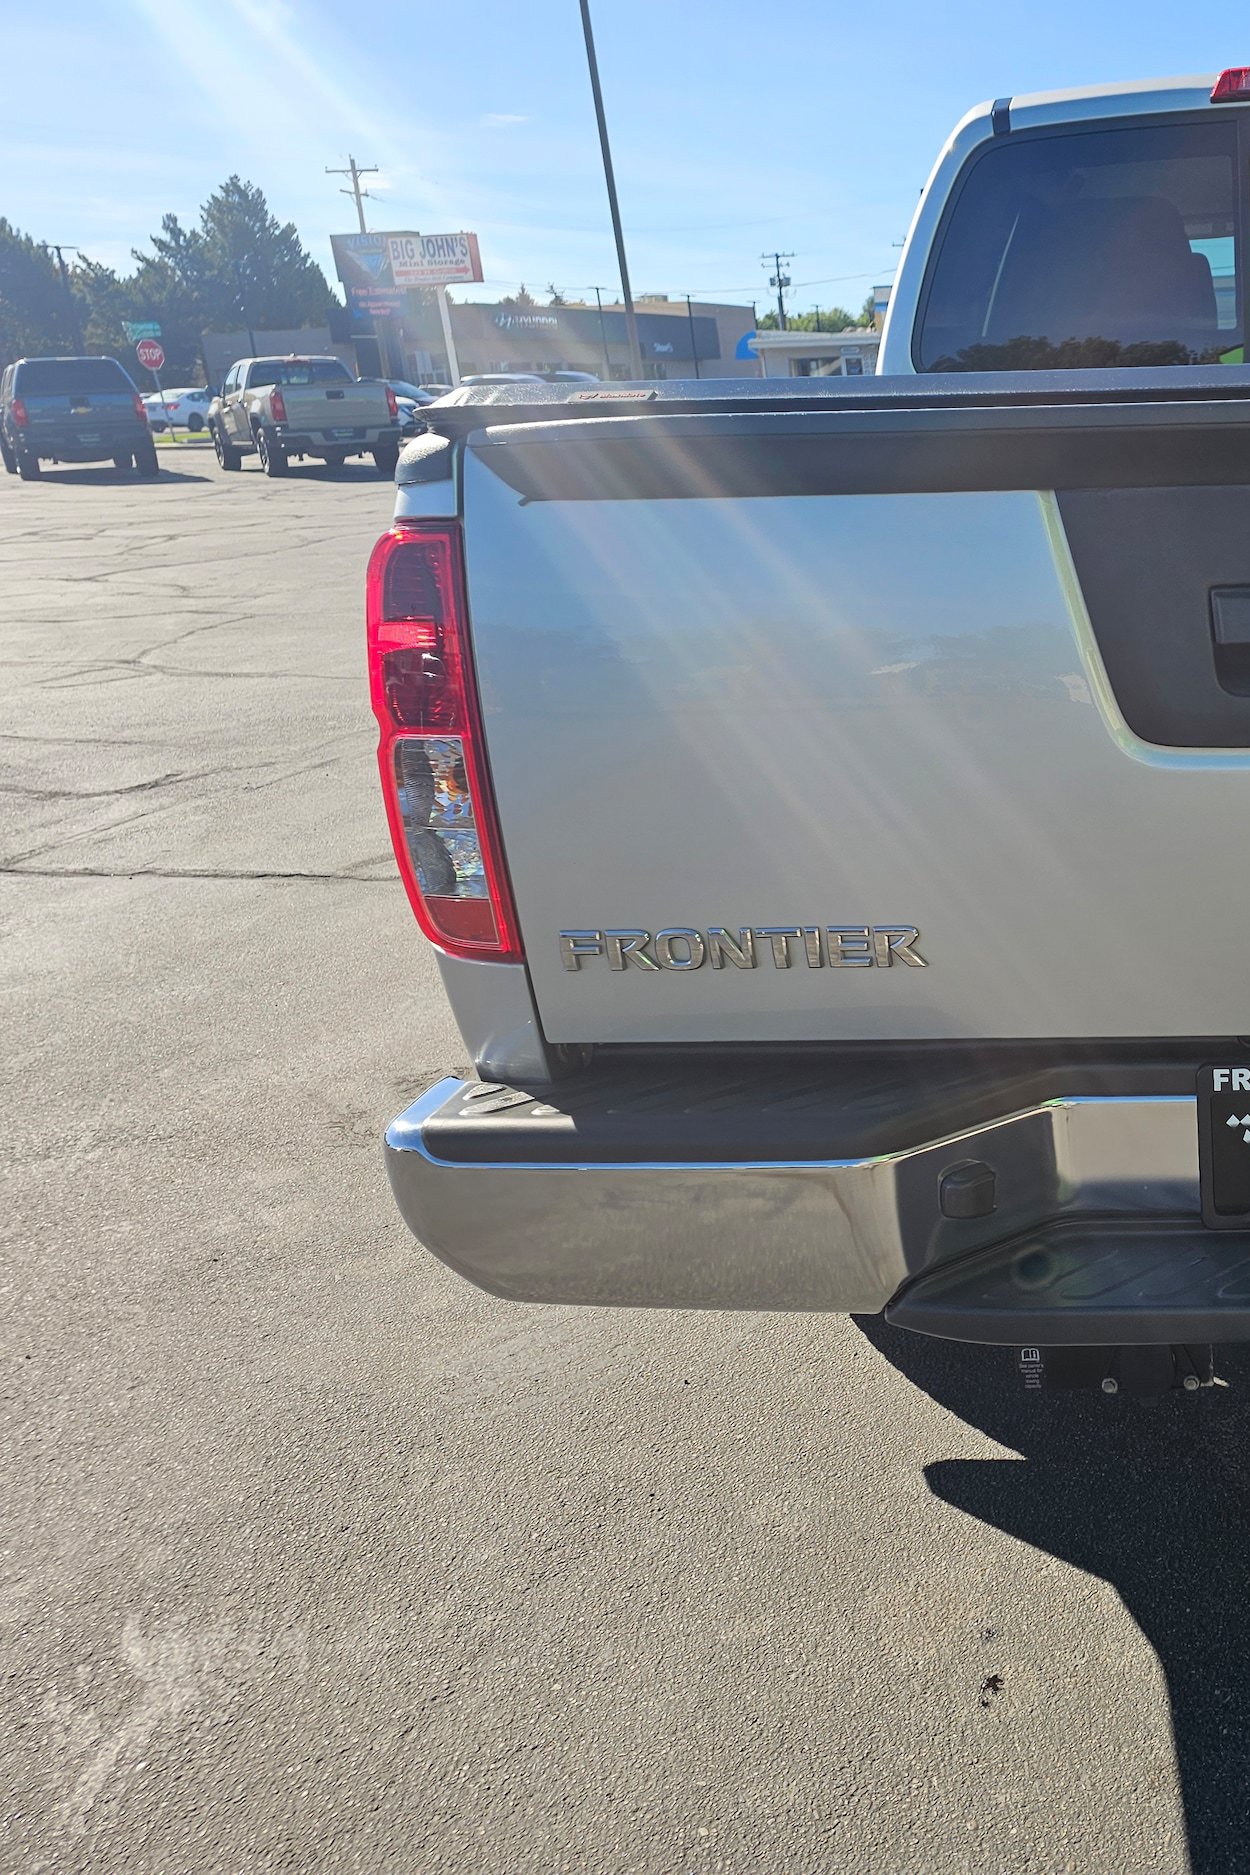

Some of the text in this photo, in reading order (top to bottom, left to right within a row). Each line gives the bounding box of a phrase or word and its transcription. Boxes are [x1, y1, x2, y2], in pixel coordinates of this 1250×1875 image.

[390, 236, 468, 260] BIG JOHN'S
[427, 258, 466, 267] Storage
[140, 348, 161, 360] STOP
[559, 925, 930, 971] FRONTIER
